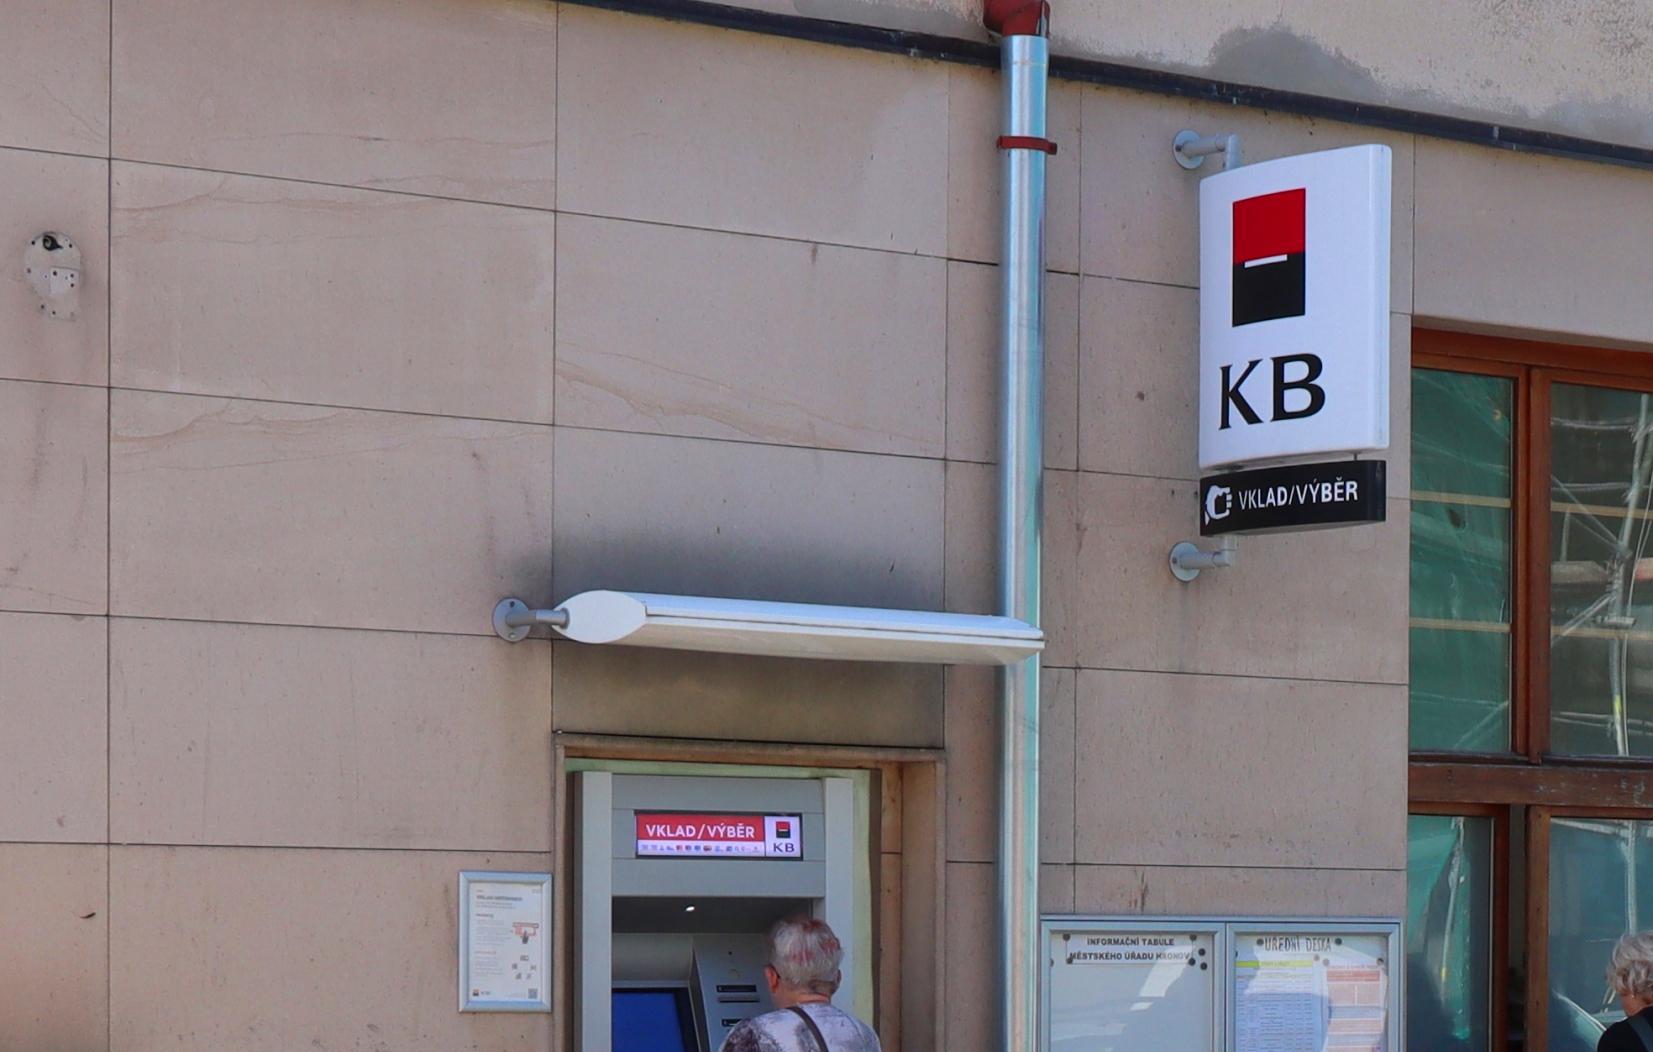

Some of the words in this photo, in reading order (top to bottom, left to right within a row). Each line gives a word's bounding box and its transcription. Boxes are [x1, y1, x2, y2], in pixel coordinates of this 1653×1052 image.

[1218, 352, 1327, 431] KB
[1238, 476, 1359, 511] VKLAD/VÝBĚR
[772, 842, 795, 853] KB
[1086, 936, 1140, 946] INFORMAČNÍ
[1142, 938, 1175, 946] TABULE
[1305, 937, 1332, 953] DESKA
[1069, 950, 1122, 961] MĚSTSKÉHO
[1124, 950, 1154, 961] ÚŘADU
